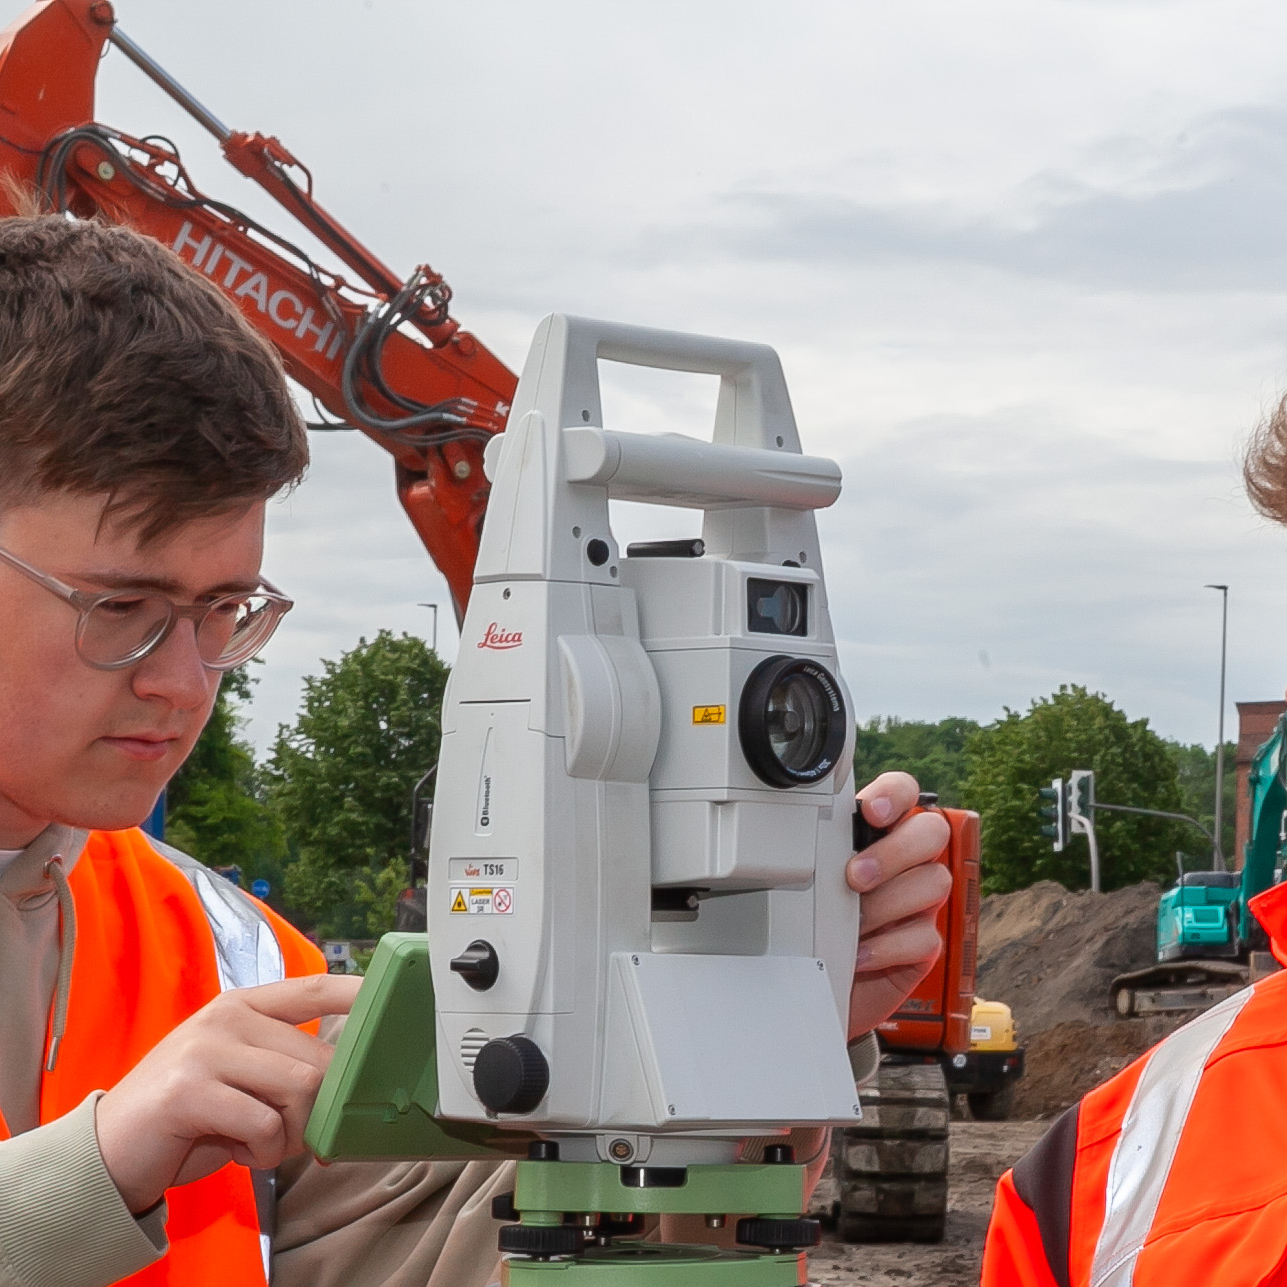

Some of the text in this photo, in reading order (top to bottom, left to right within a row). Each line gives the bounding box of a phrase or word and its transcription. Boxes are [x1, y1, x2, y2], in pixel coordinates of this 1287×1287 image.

[172, 221, 346, 361] HITACHI
[477, 622, 523, 650] Leica
[483, 863, 504, 876] TS16
